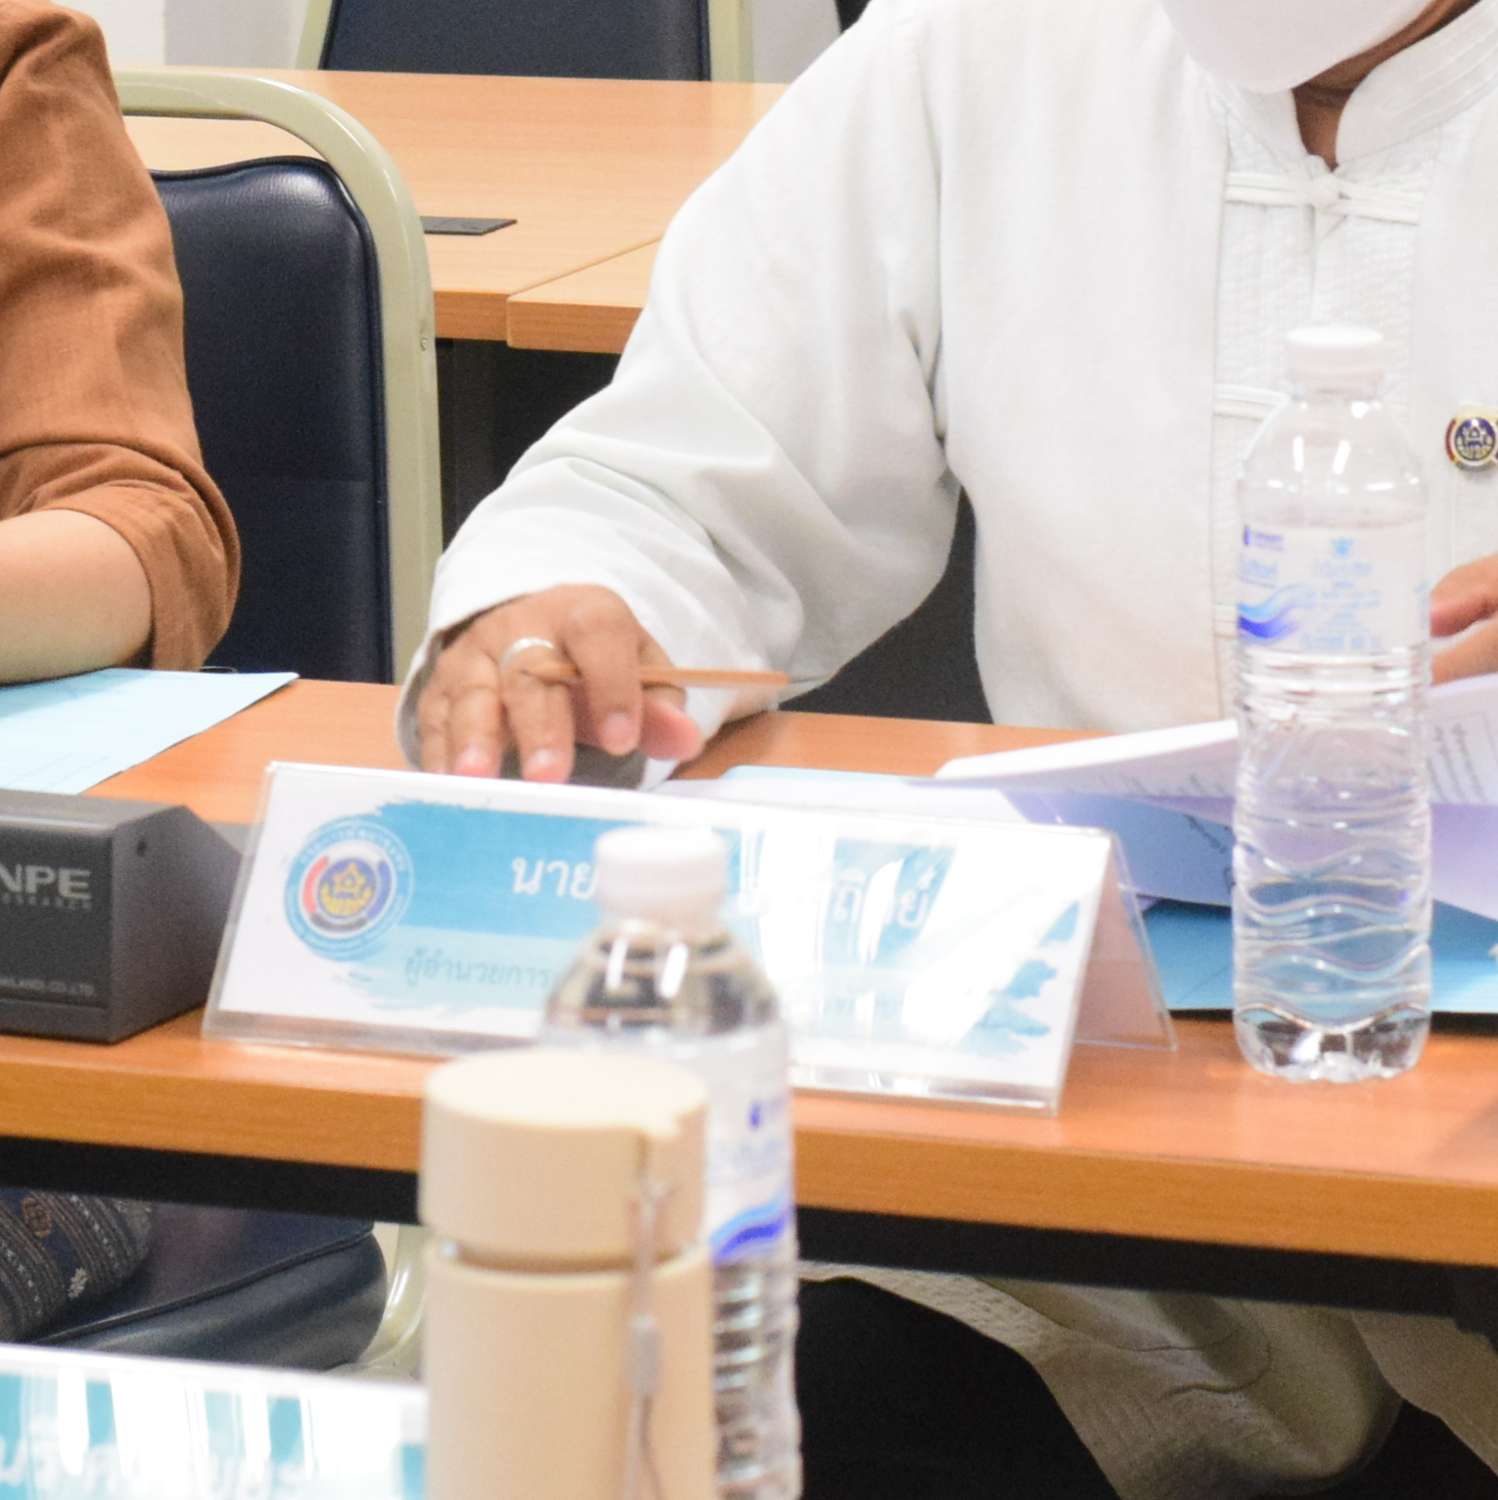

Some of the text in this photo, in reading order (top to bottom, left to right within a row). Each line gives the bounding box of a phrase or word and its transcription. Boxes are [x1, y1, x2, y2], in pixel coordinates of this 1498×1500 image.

[403, 946, 561, 989] ผู้อำนวยการ
